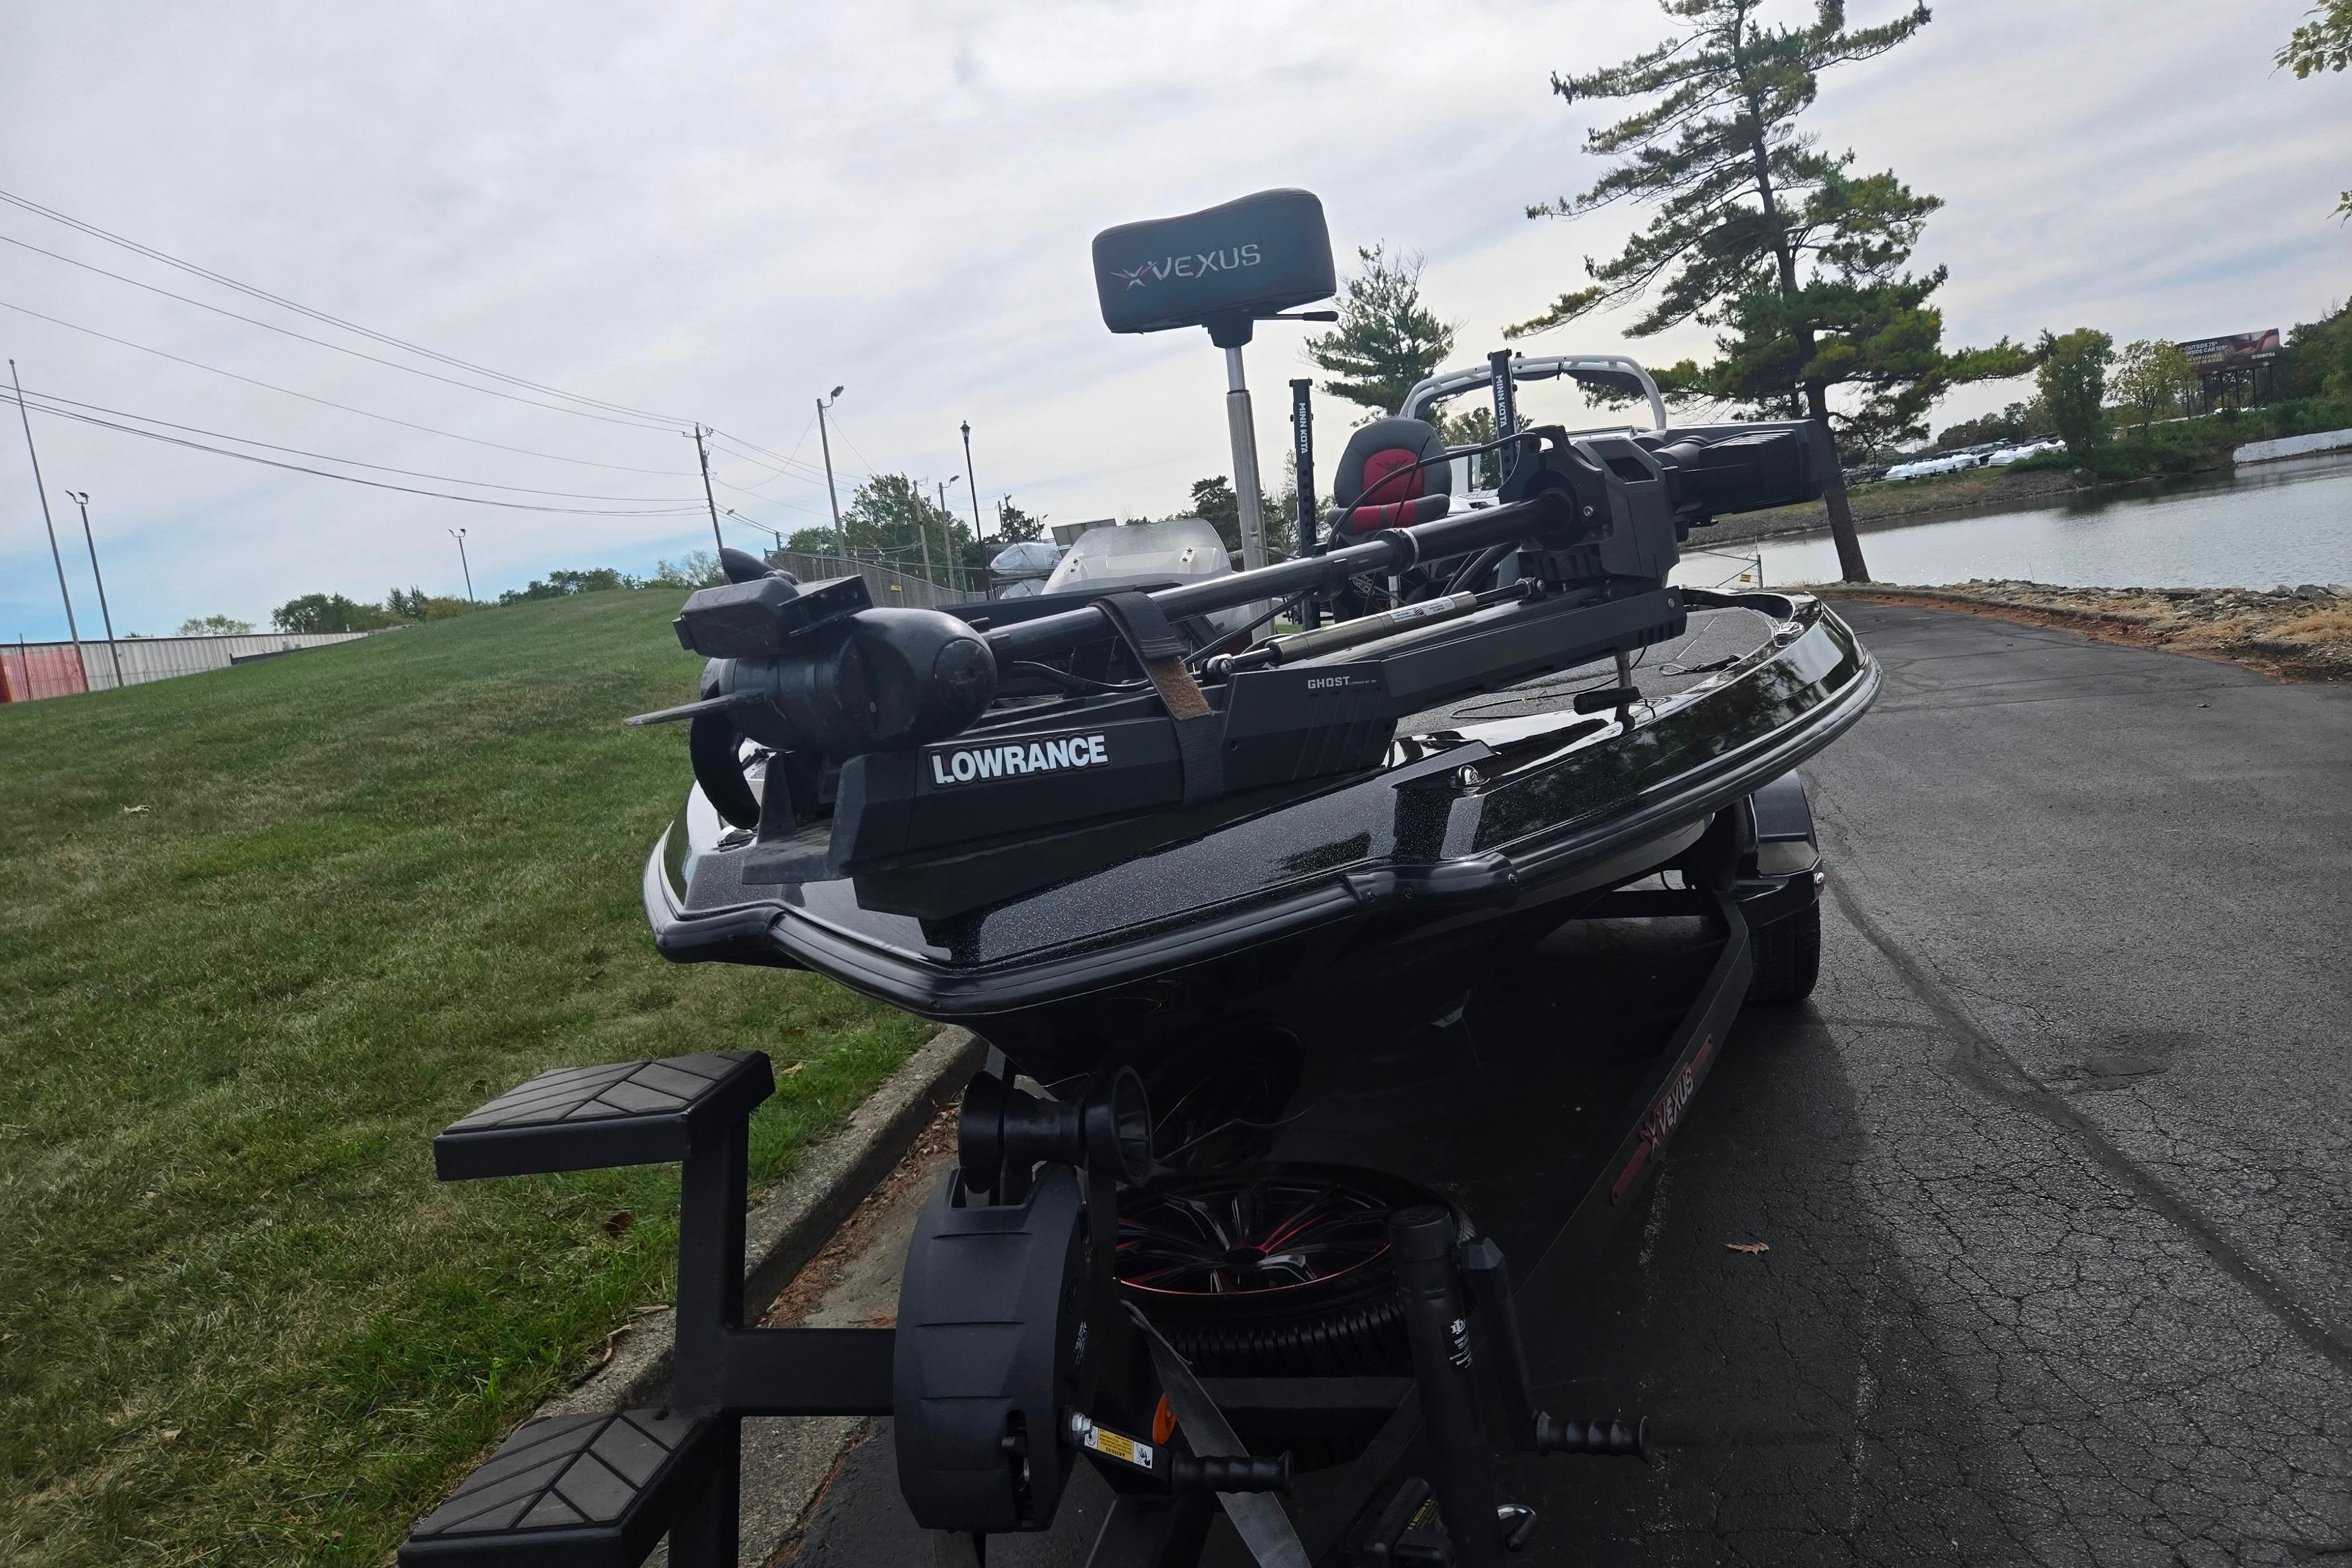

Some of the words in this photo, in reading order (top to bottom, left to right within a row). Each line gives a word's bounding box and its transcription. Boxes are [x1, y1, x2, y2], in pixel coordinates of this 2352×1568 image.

[1148, 244, 1261, 281] VEXUS
[1496, 375, 1505, 401] MINN
[1498, 402, 1507, 428] KOTA
[1300, 429, 1308, 454] KOTA
[1308, 676, 1350, 689] GHOST
[932, 735, 1108, 784] LOWRANCE
[1658, 1066, 1693, 1135] VEXUS
